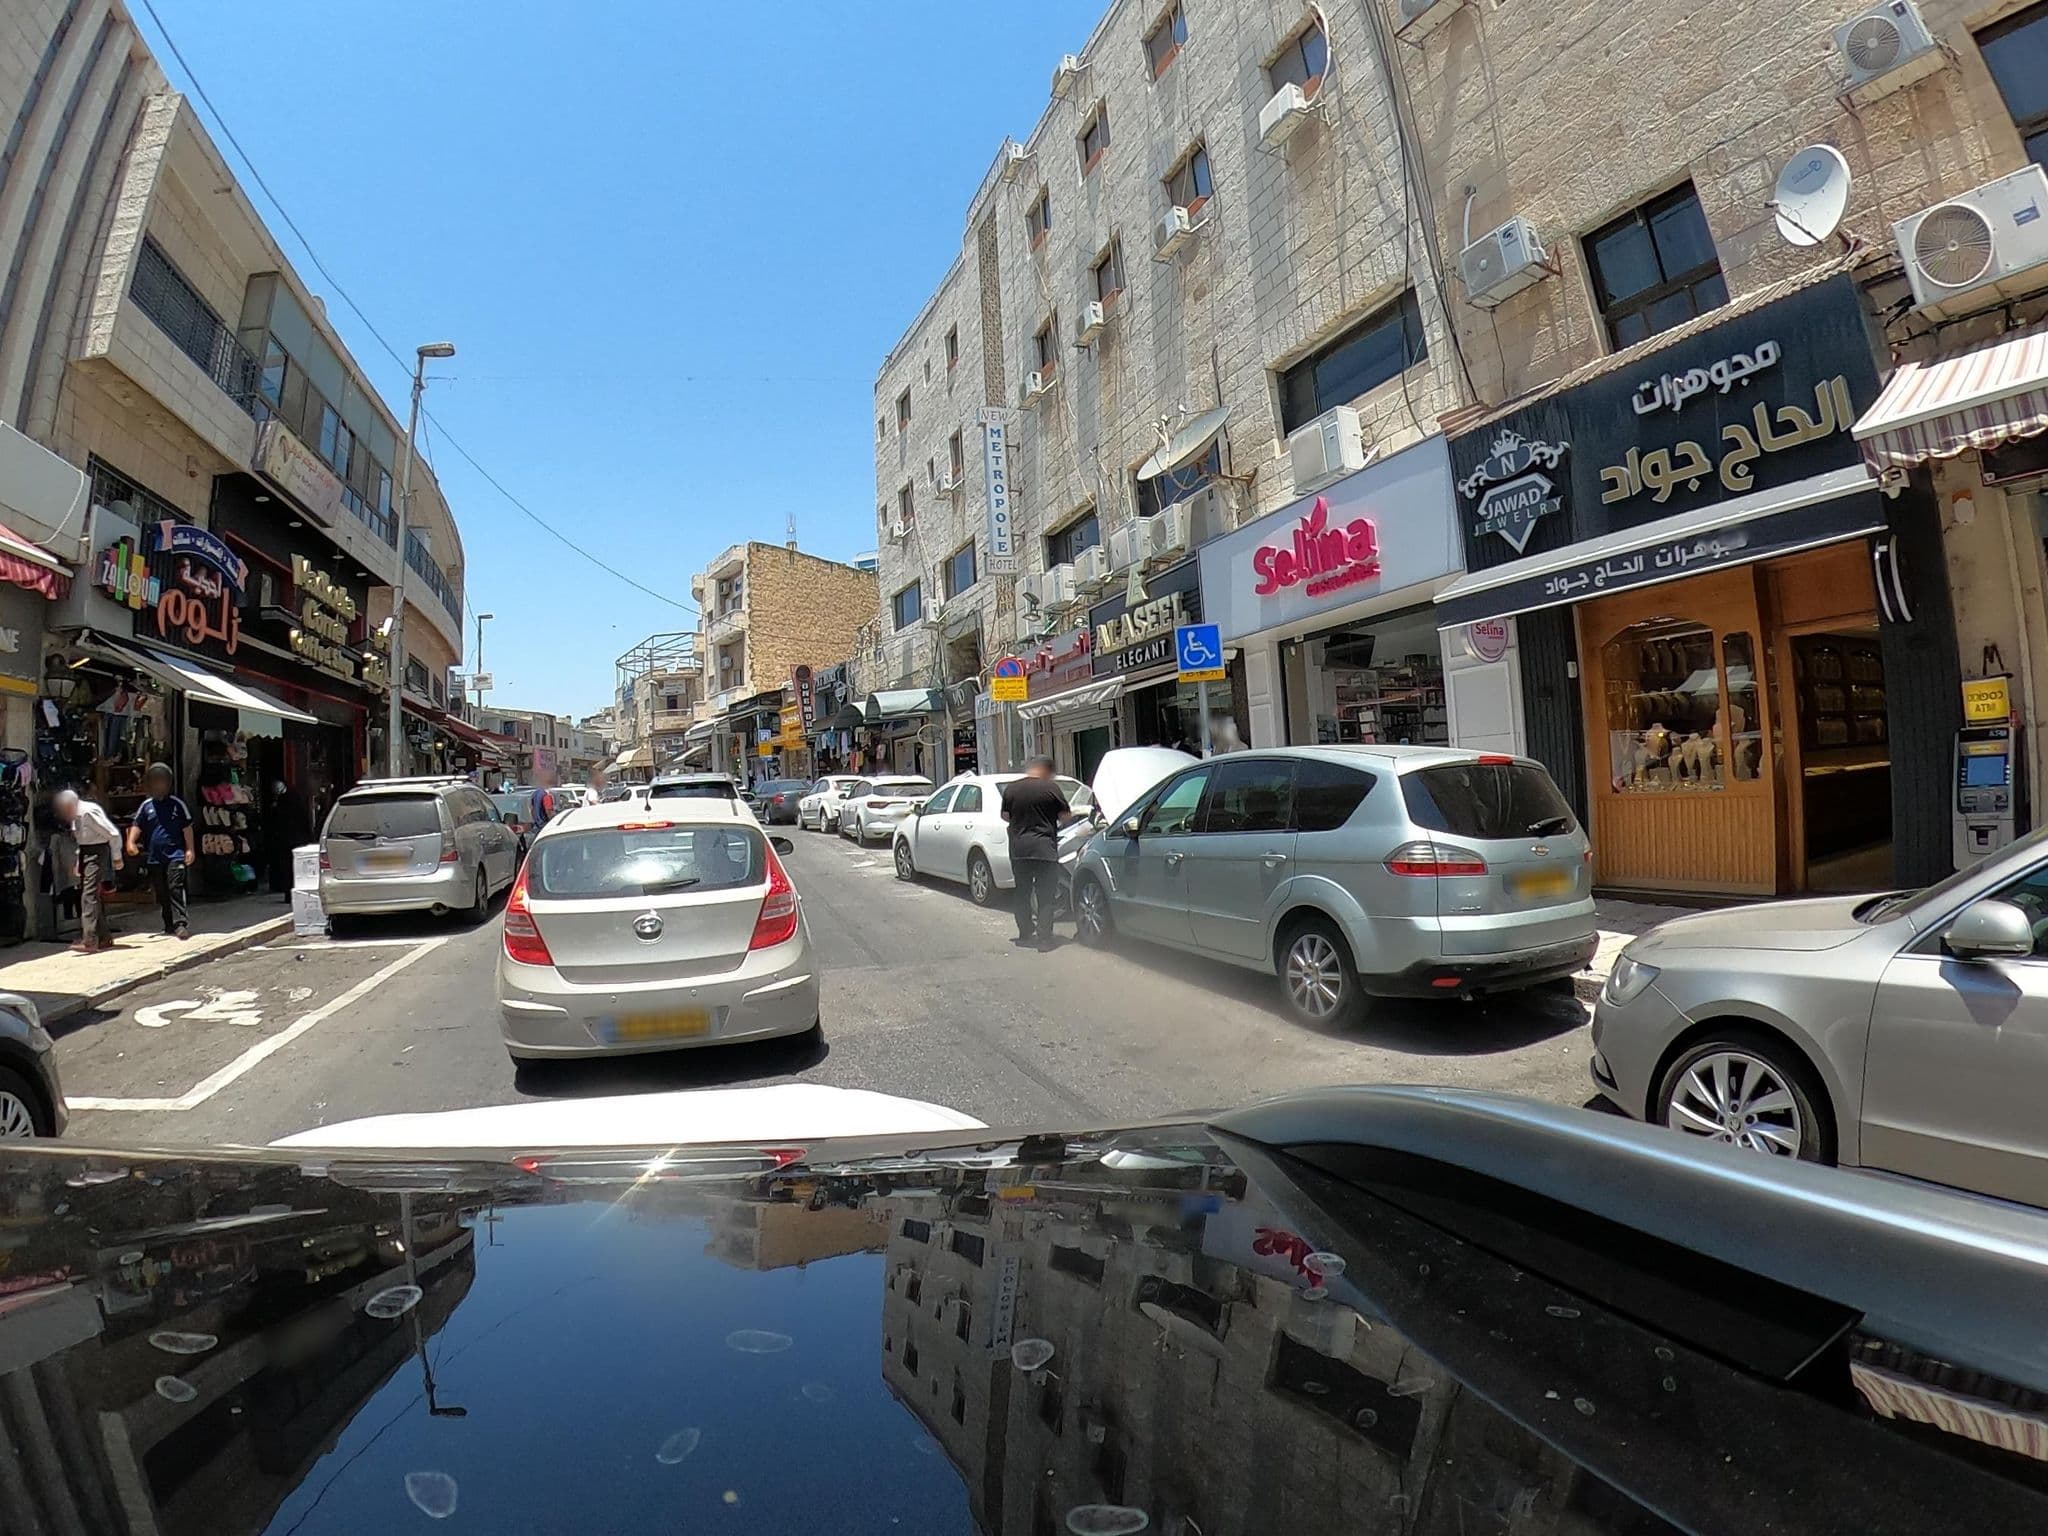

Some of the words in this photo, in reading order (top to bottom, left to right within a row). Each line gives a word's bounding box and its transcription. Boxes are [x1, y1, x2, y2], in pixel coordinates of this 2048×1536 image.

[1631, 340, 1782, 415] مجوهرات
[981, 410, 1007, 421] NEW
[1720, 375, 1855, 491] الحاج
[1501, 453, 1516, 476] N
[1600, 441, 1713, 504] جواد
[990, 427, 1008, 553] METROPOLE
[1487, 488, 1541, 519] JAWAD
[1474, 495, 1564, 537] JEWELRY
[989, 559, 1017, 570] HOTEL
[1253, 498, 1379, 595] Selina
[102, 560, 161, 609] ZALLOUM
[1545, 572, 1589, 595] جواد
[1594, 555, 1645, 586] الحاج
[158, 587, 242, 656] زلوم
[1475, 622, 1505, 637] Selina
[1116, 640, 1168, 671] ELEGANT
